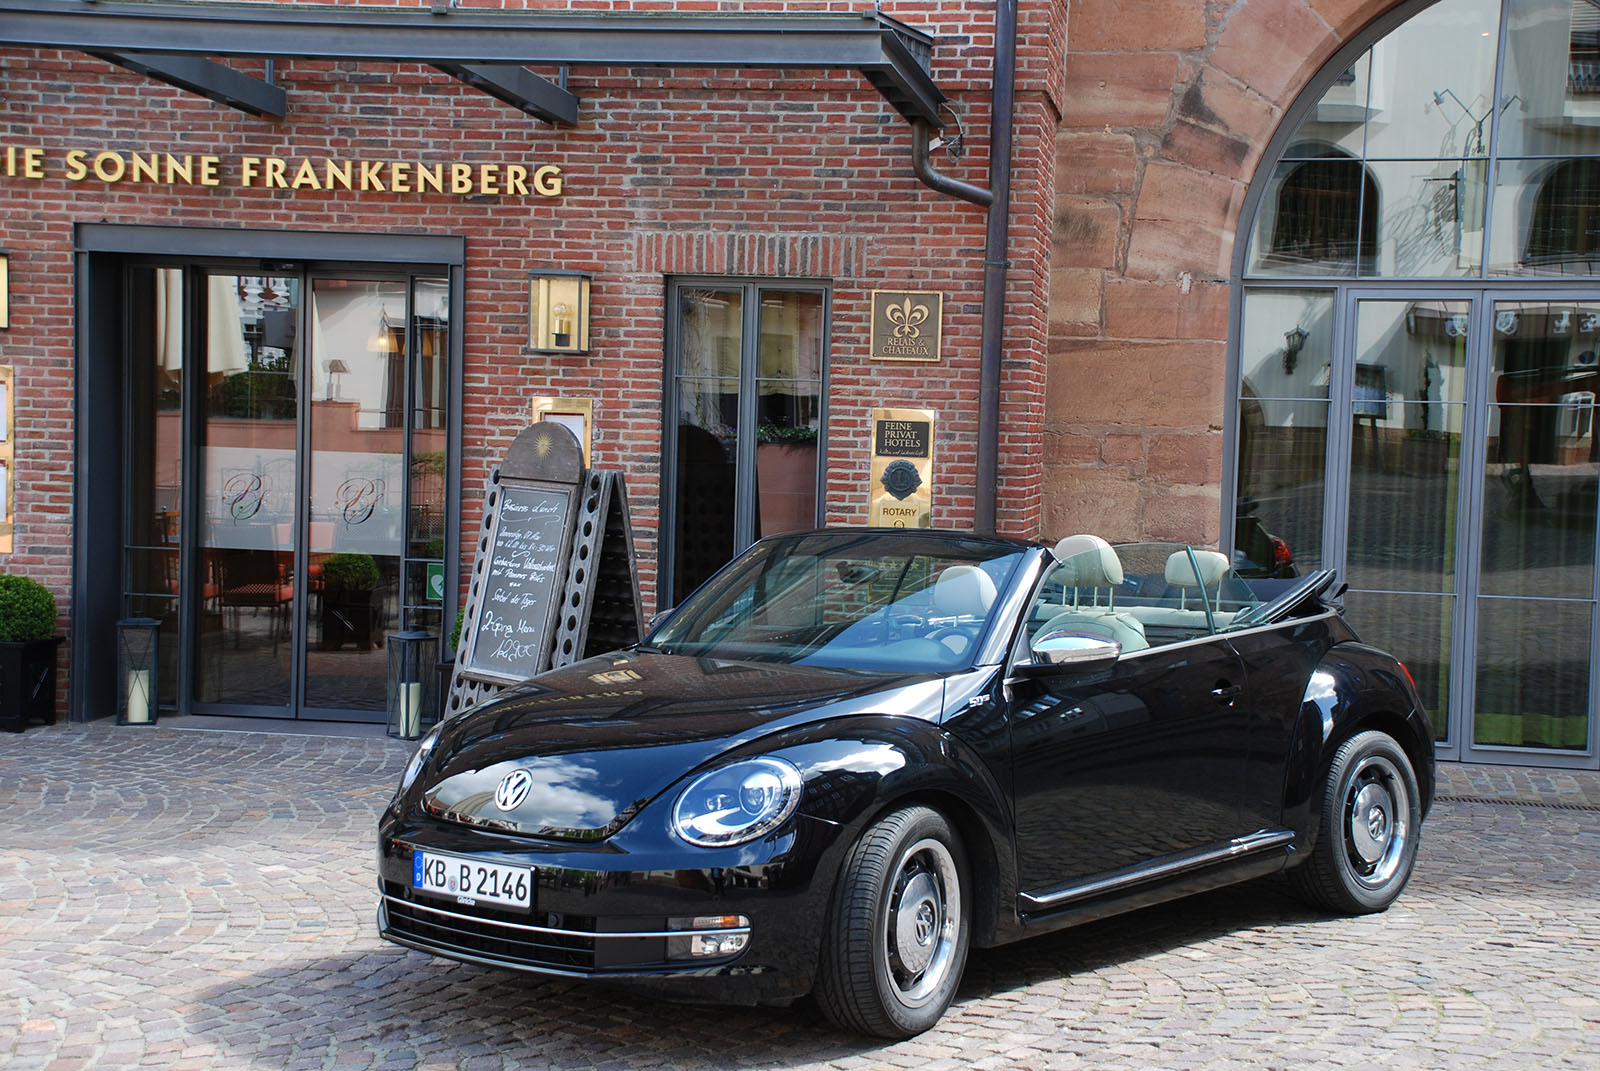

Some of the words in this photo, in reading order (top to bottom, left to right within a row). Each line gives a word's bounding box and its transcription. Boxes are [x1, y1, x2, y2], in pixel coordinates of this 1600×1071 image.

[0, 146, 45, 179] IE
[65, 149, 221, 186] SONNE
[241, 156, 564, 197] FRANKENBERG
[887, 337, 916, 347] RELAIS
[918, 339, 926, 347] &
[885, 421, 913, 430] FEINE
[884, 430, 918, 439] PRIVAT
[884, 438, 921, 448] HOTELS
[882, 507, 917, 516] ROTARY
[424, 857, 447, 887] KB
[460, 864, 472, 892] B
[476, 867, 527, 901] 2146
